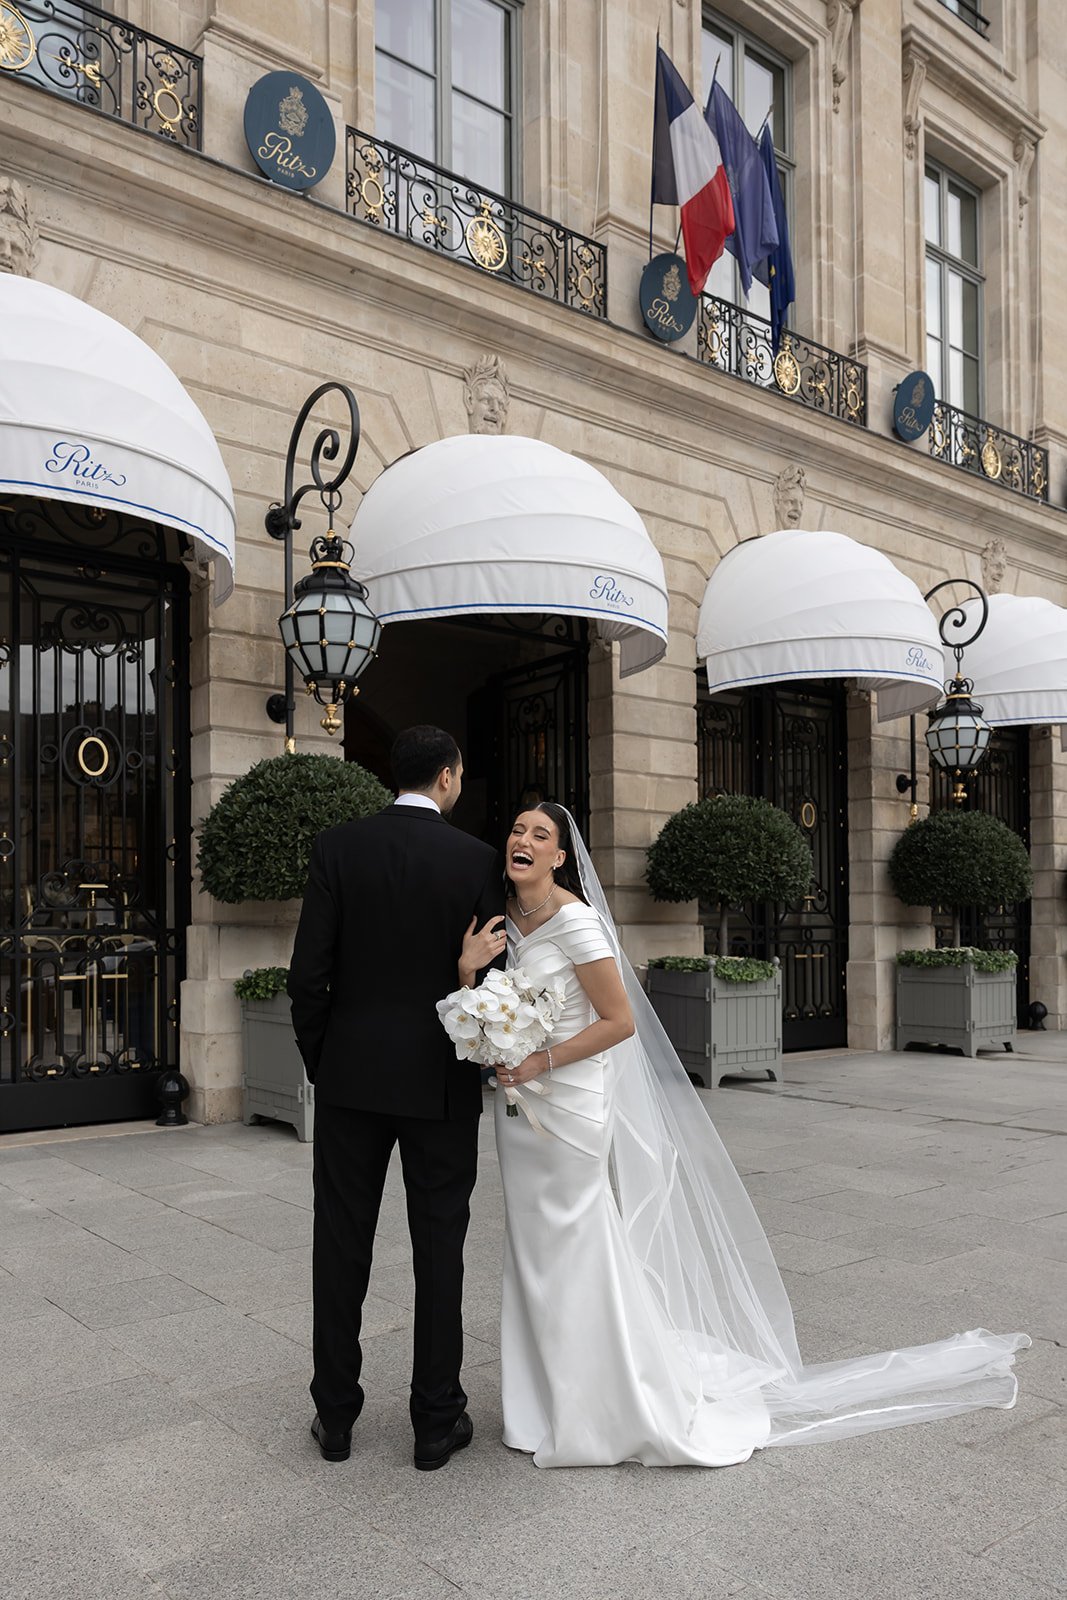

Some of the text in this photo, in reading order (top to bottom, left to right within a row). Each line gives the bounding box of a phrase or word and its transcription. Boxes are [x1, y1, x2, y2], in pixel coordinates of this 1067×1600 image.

[257, 132, 316, 178] Ritz
[277, 167, 295, 178] PARIS
[647, 298, 684, 333] Ritz
[897, 406, 924, 432] Ritz
[45, 441, 127, 487] Ritz
[75, 479, 99, 489] PARIS
[589, 575, 634, 607] Ritz
